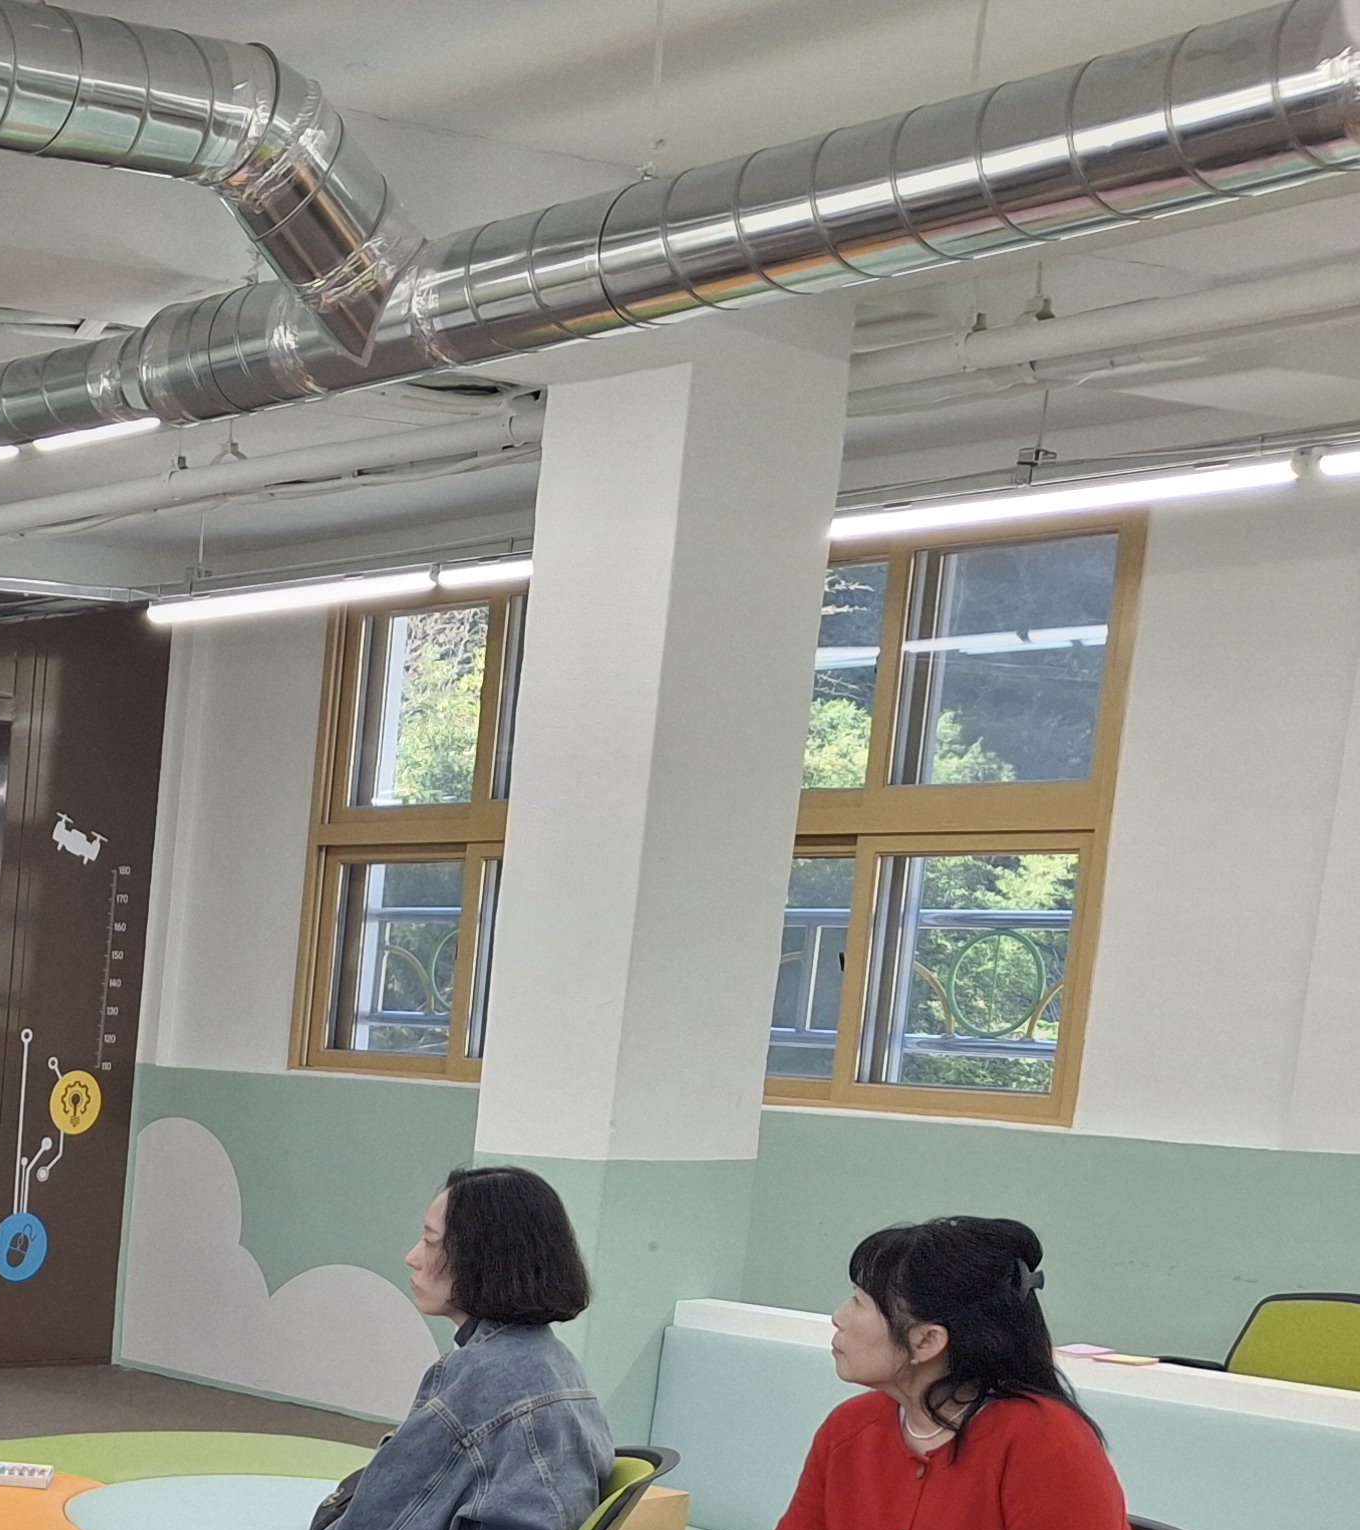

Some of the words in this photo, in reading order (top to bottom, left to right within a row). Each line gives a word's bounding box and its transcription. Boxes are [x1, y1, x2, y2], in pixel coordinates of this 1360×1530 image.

[118, 866, 131, 875] 180
[116, 894, 129, 904] 170
[114, 922, 127, 932] 160
[111, 950, 124, 960] 150
[104, 1034, 117, 1043] 120
